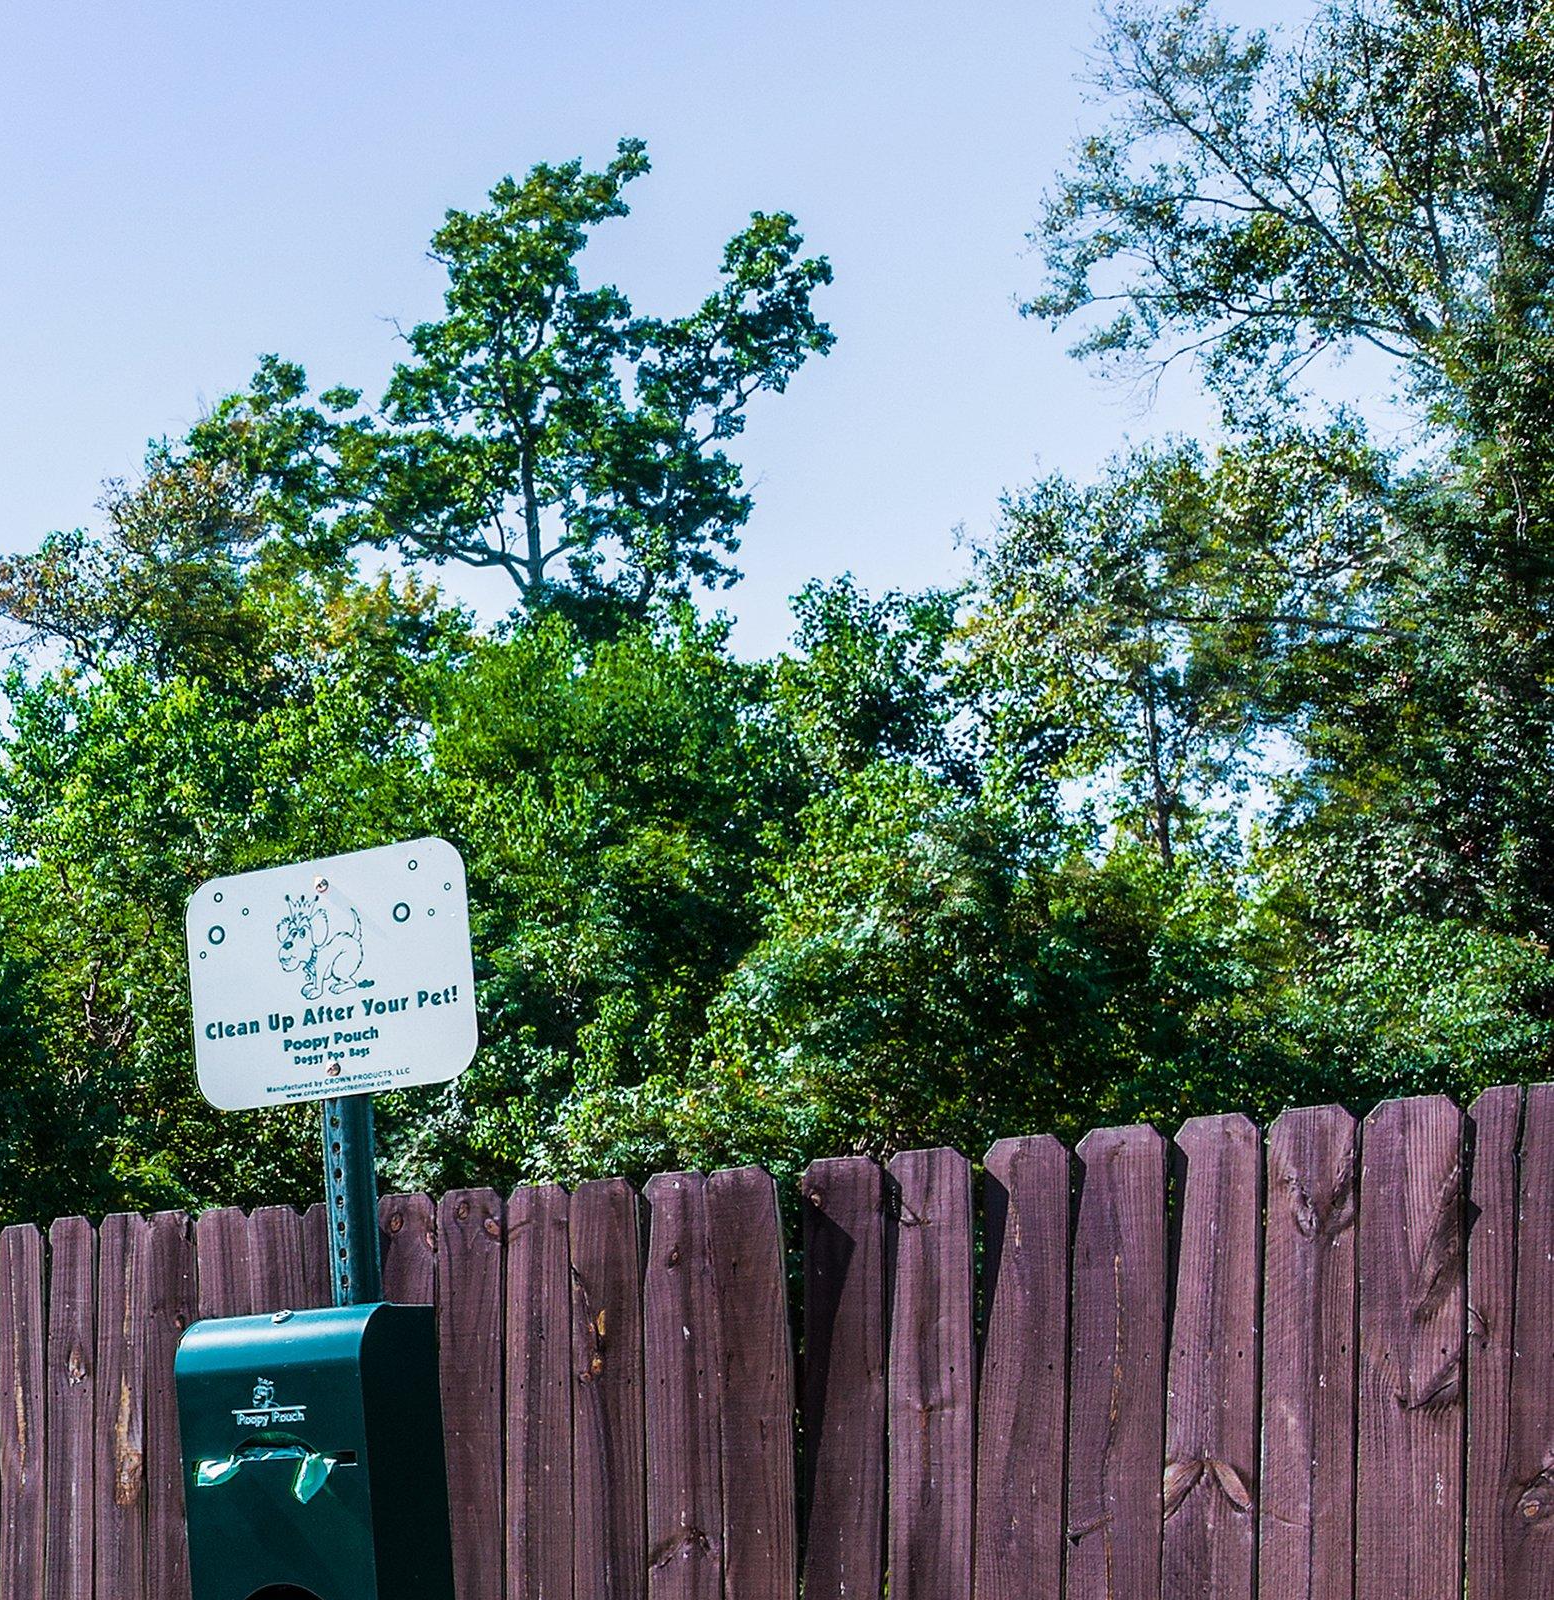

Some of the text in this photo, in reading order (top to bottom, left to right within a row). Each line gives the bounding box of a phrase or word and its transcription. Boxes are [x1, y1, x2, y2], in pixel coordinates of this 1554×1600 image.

[205, 985, 459, 1041] Clean Up After Your Pet!
[283, 1026, 379, 1052] Poopy Pouch
[327, 1050, 345, 1061] Poo
[349, 1046, 371, 1058] Bags
[266, 1081, 313, 1094] Manufactured
[324, 1076, 352, 1085] CROWN
[396, 1067, 411, 1076] LLC
[237, 1410, 304, 1427] Poopy Pouch
